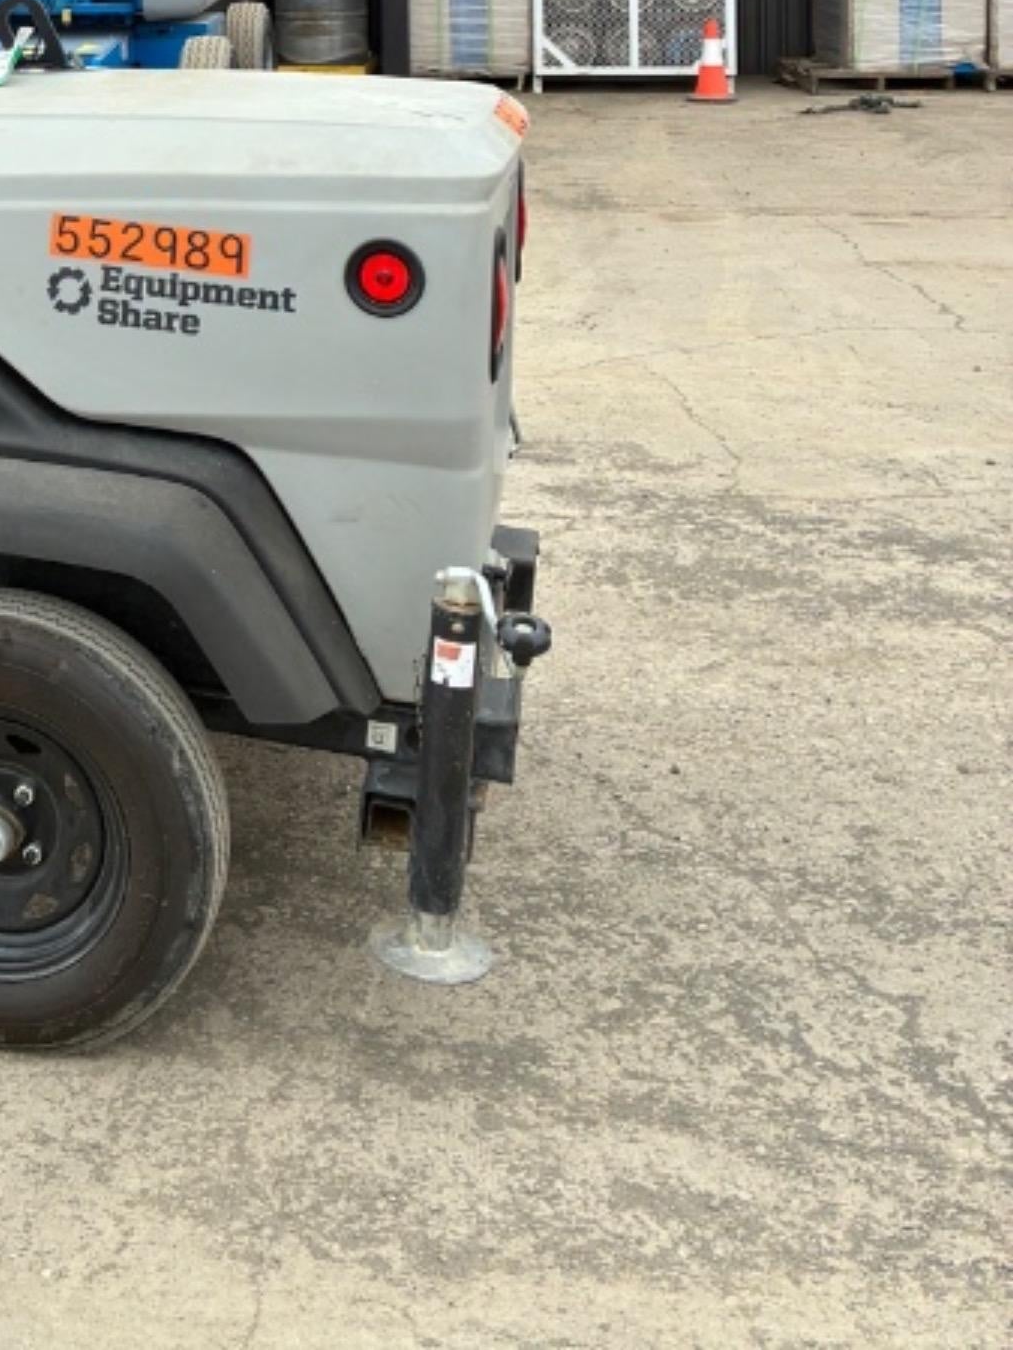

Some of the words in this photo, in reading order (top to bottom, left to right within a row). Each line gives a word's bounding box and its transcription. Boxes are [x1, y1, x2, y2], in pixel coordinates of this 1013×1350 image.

[56, 216, 244, 274] 552989
[101, 265, 296, 313] Equipment
[97, 298, 201, 335] Share
